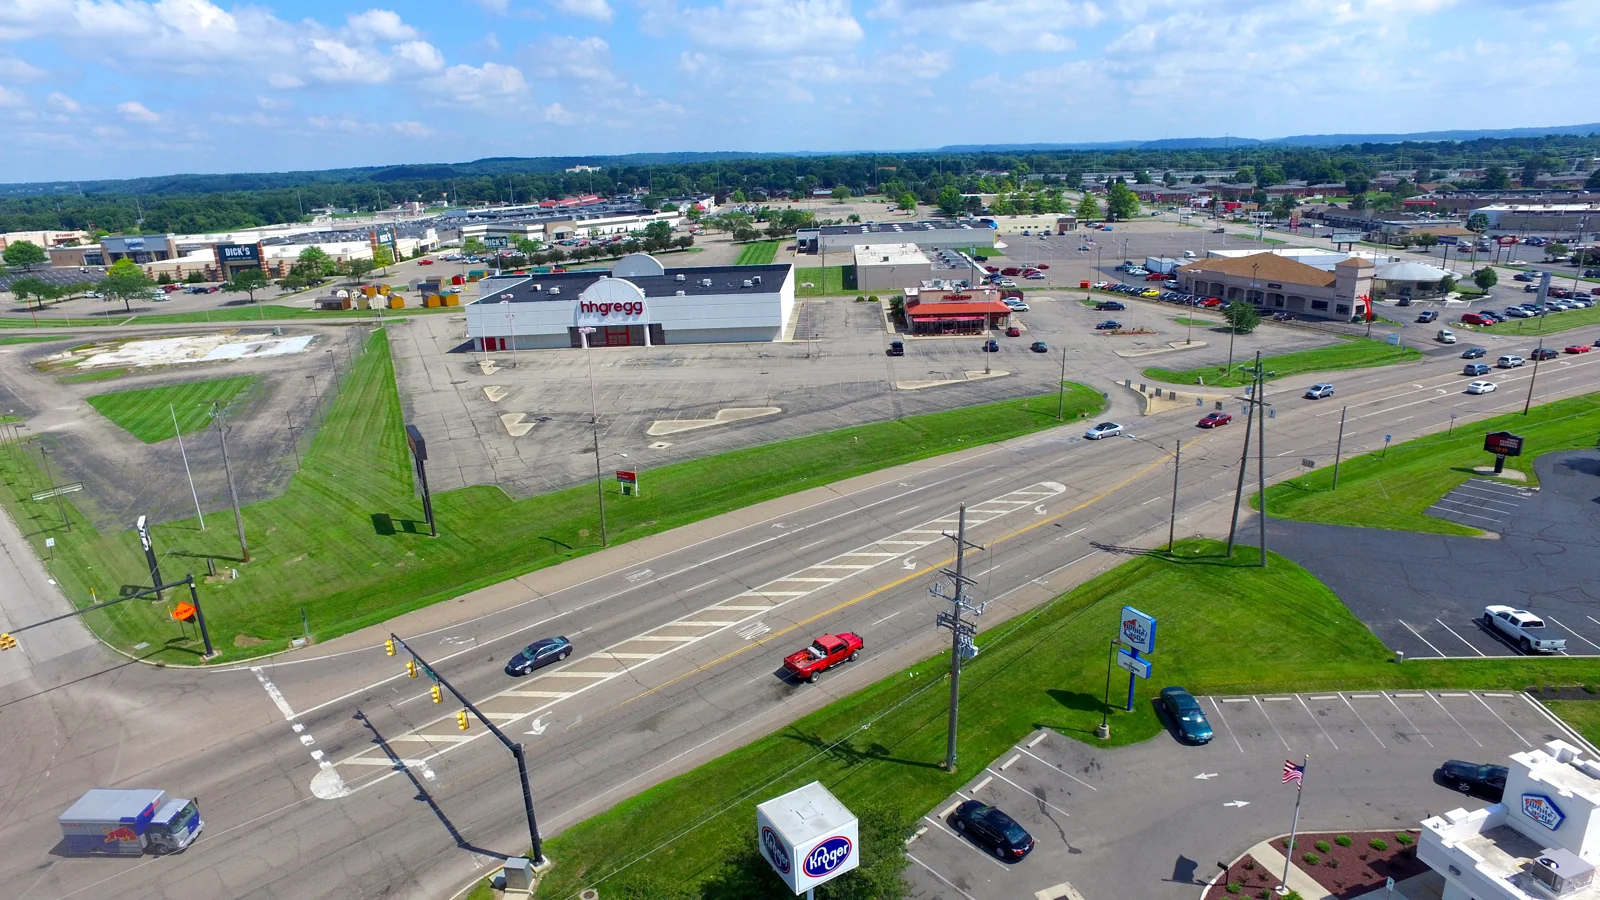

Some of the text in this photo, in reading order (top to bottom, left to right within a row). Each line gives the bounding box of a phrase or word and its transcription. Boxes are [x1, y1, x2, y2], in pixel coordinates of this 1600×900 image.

[224, 247, 251, 257] DICK'S
[580, 301, 643, 316] hhgregg
[175, 607, 192, 617] BUMP
[1124, 629, 1146, 643] Castle
[1126, 623, 1146, 637] White
[1525, 806, 1553, 824] Castle
[1529, 800, 1553, 818] White
[764, 830, 789, 867] Kroger
[809, 844, 849, 870] Kroger
